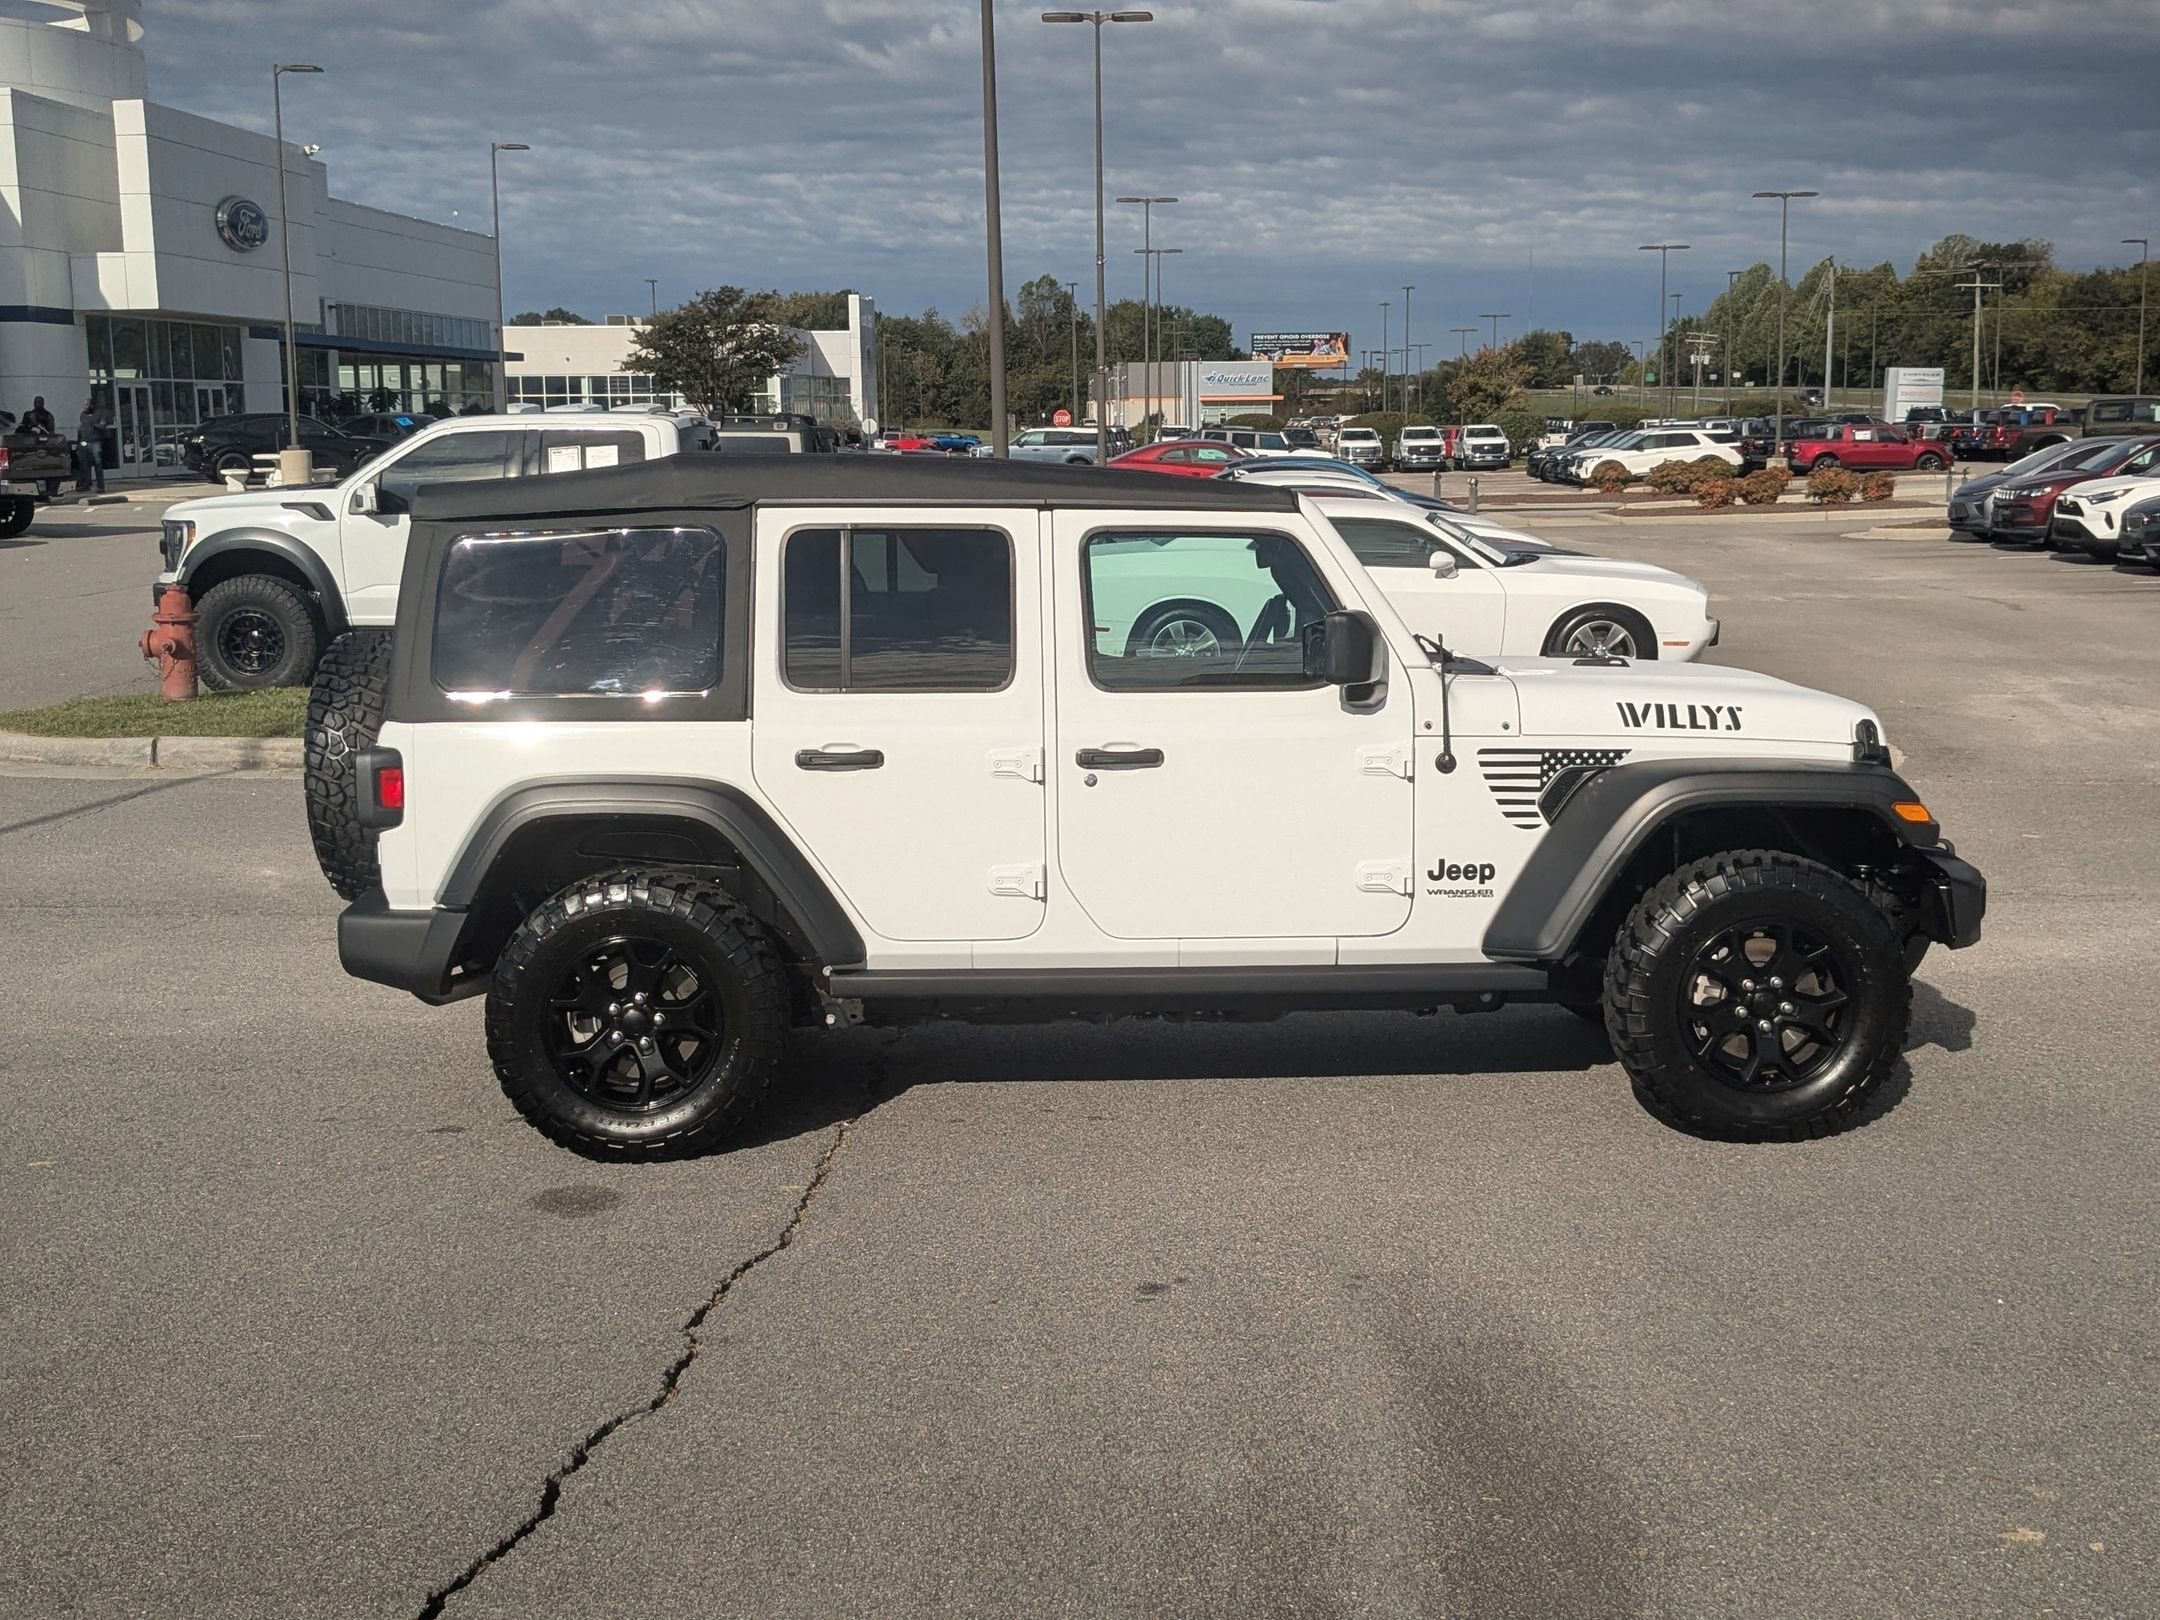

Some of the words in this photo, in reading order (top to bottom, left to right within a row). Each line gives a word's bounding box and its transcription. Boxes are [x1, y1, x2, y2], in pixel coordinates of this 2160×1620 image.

[238, 209, 263, 239] Ford
[1217, 374, 1244, 383] Quick
[1244, 374, 1269, 383] Lane
[1055, 415, 1070, 423] STOP
[1616, 702, 1743, 731] WILLYS
[1427, 858, 1495, 884] Jeep
